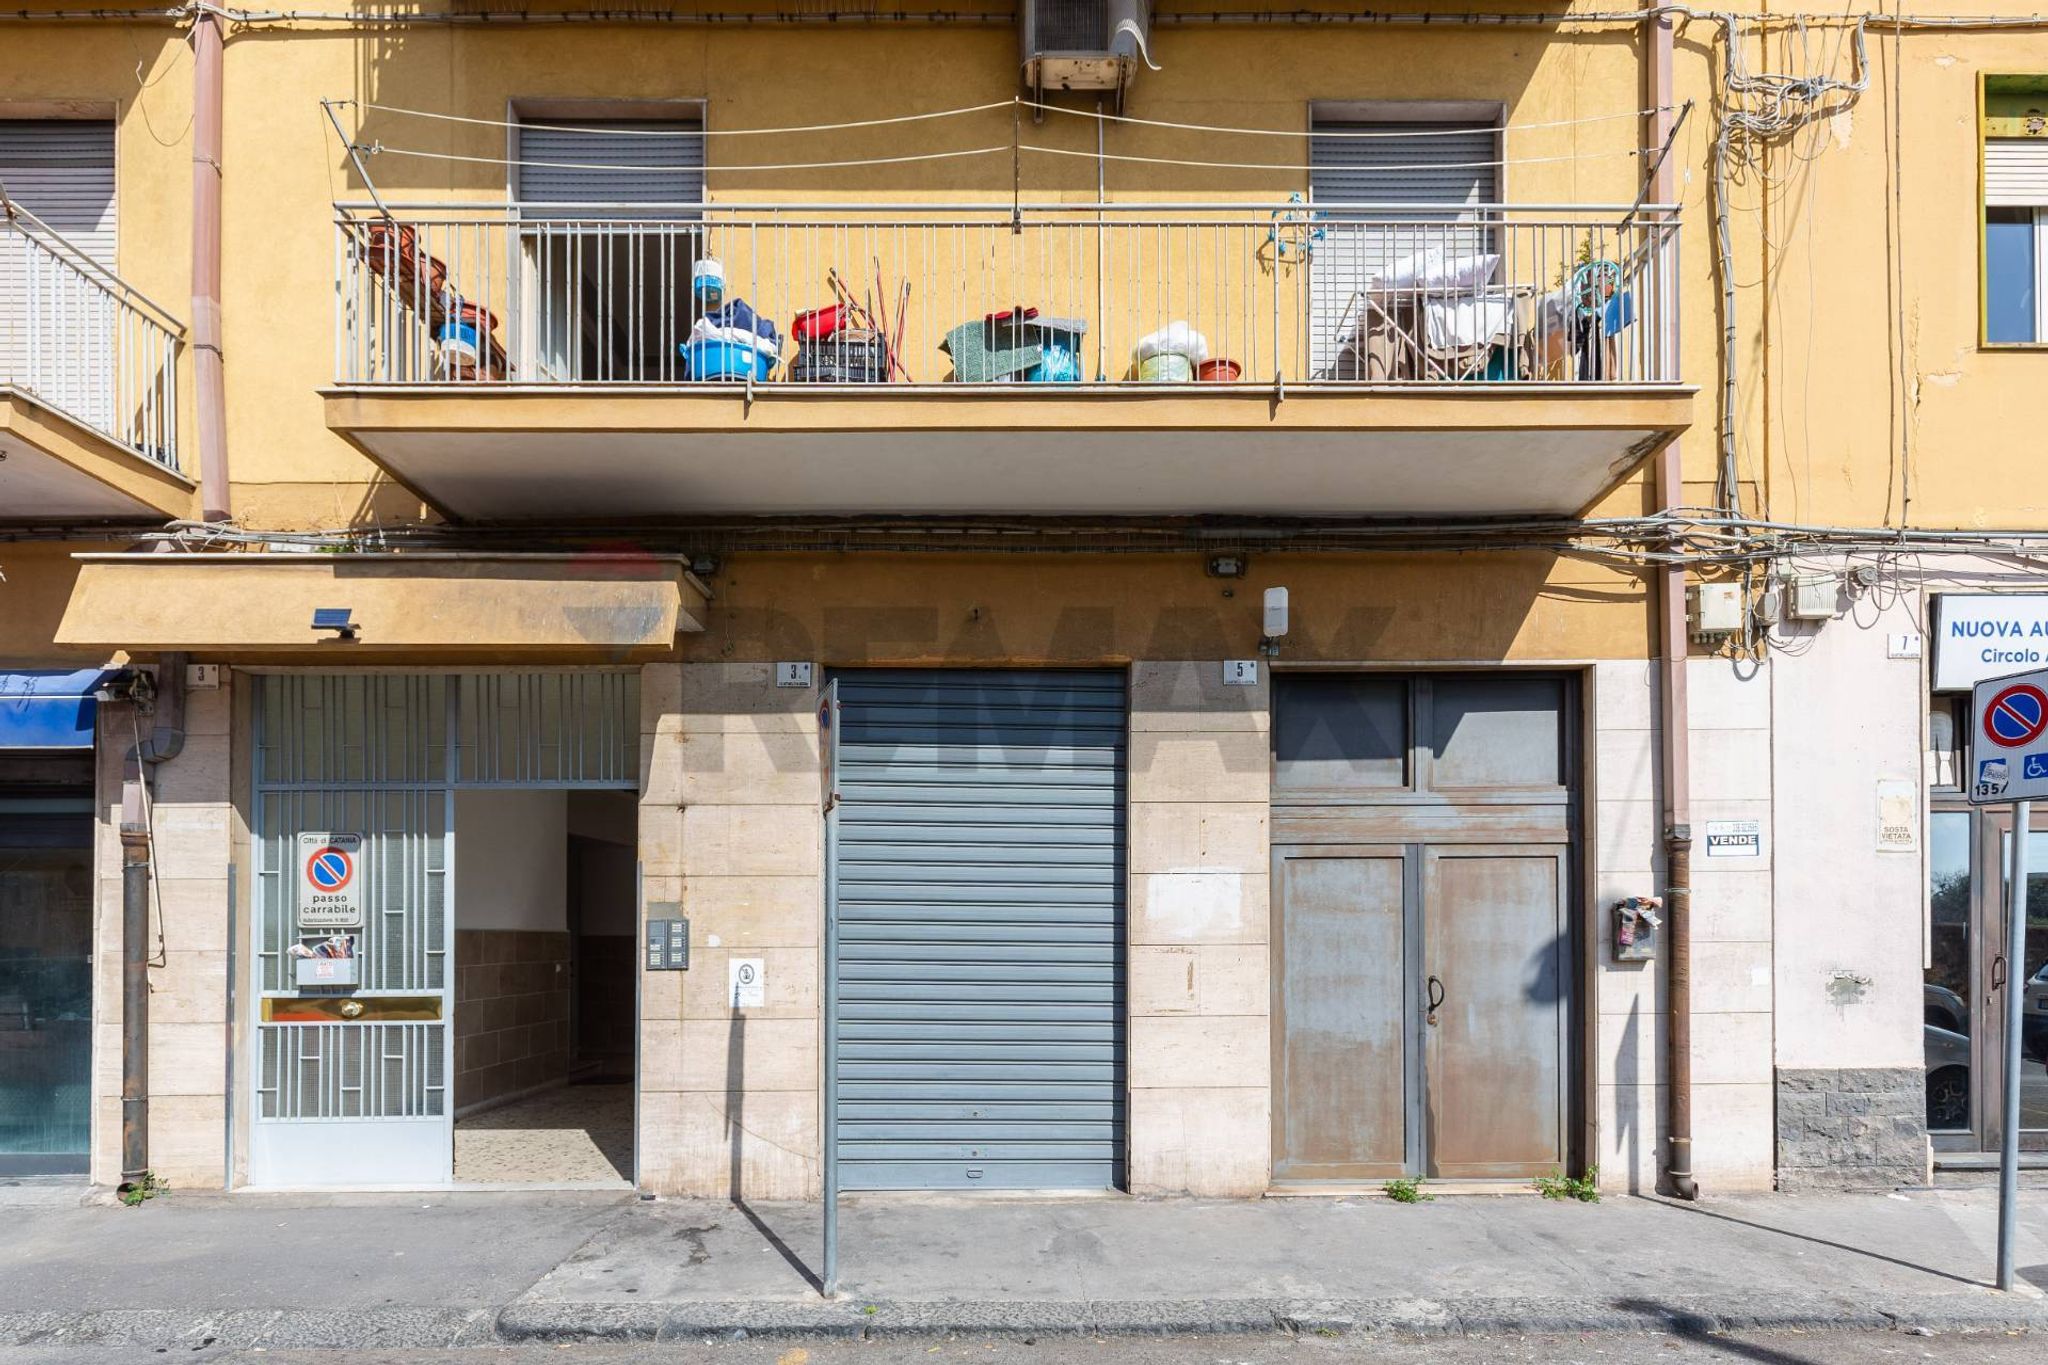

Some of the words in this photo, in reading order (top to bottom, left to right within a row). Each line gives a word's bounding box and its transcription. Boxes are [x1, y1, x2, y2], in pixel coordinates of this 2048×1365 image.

[1952, 621, 2023, 638] NUOVA
[2029, 621, 2048, 638] A
[1981, 648, 2040, 663] Circolo
[198, 666, 205, 681] 3
[1237, 662, 1243, 677] 5
[1710, 836, 1756, 845] VENDE
[1881, 833, 1912, 841] VIETATA
[312, 895, 347, 905] passo
[303, 905, 356, 914] carrabile
